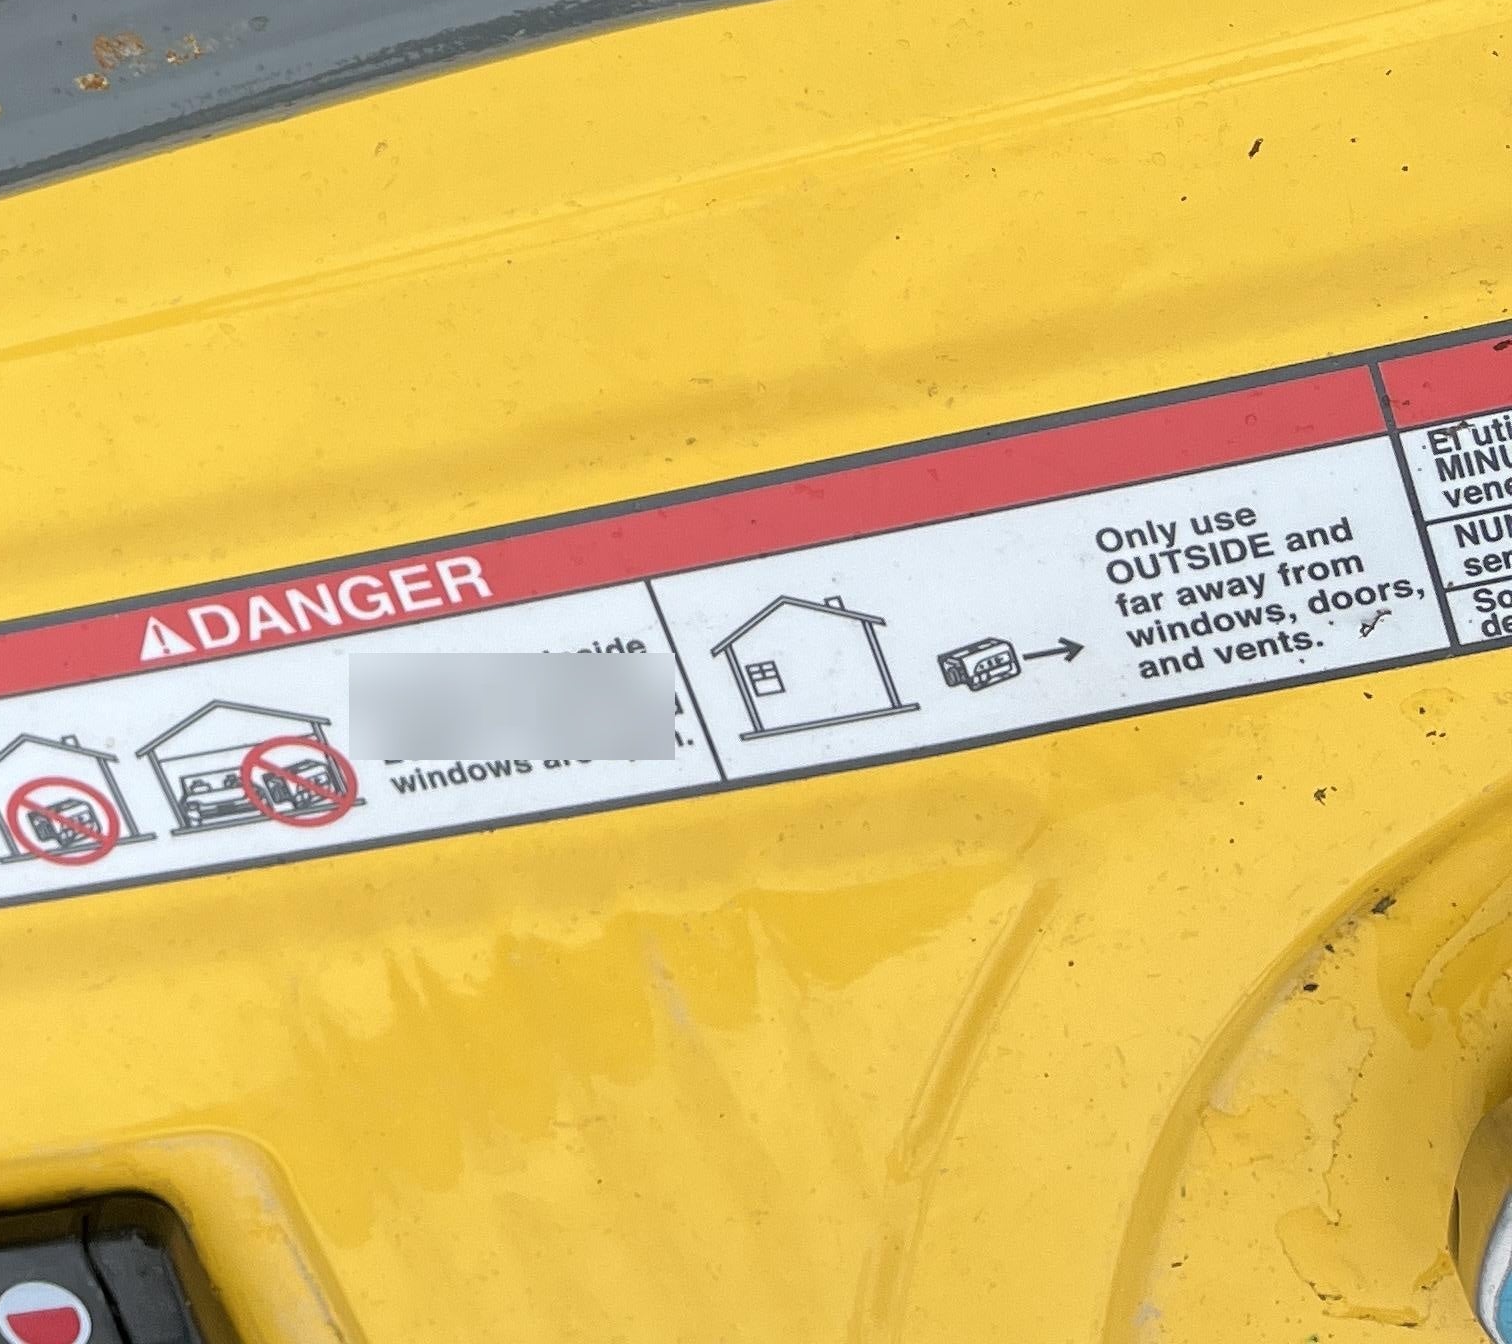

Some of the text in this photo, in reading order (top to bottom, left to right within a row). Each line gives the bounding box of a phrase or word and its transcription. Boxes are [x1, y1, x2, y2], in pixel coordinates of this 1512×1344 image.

[1094, 506, 1257, 553] Only use
[1105, 515, 1354, 585] OUTSIDE and
[187, 555, 494, 650] DANGER
[1115, 553, 1365, 617] far away from
[1125, 577, 1425, 649] windows, doors,
[1138, 628, 1325, 680] and vents.
[389, 760, 534, 795] windows
